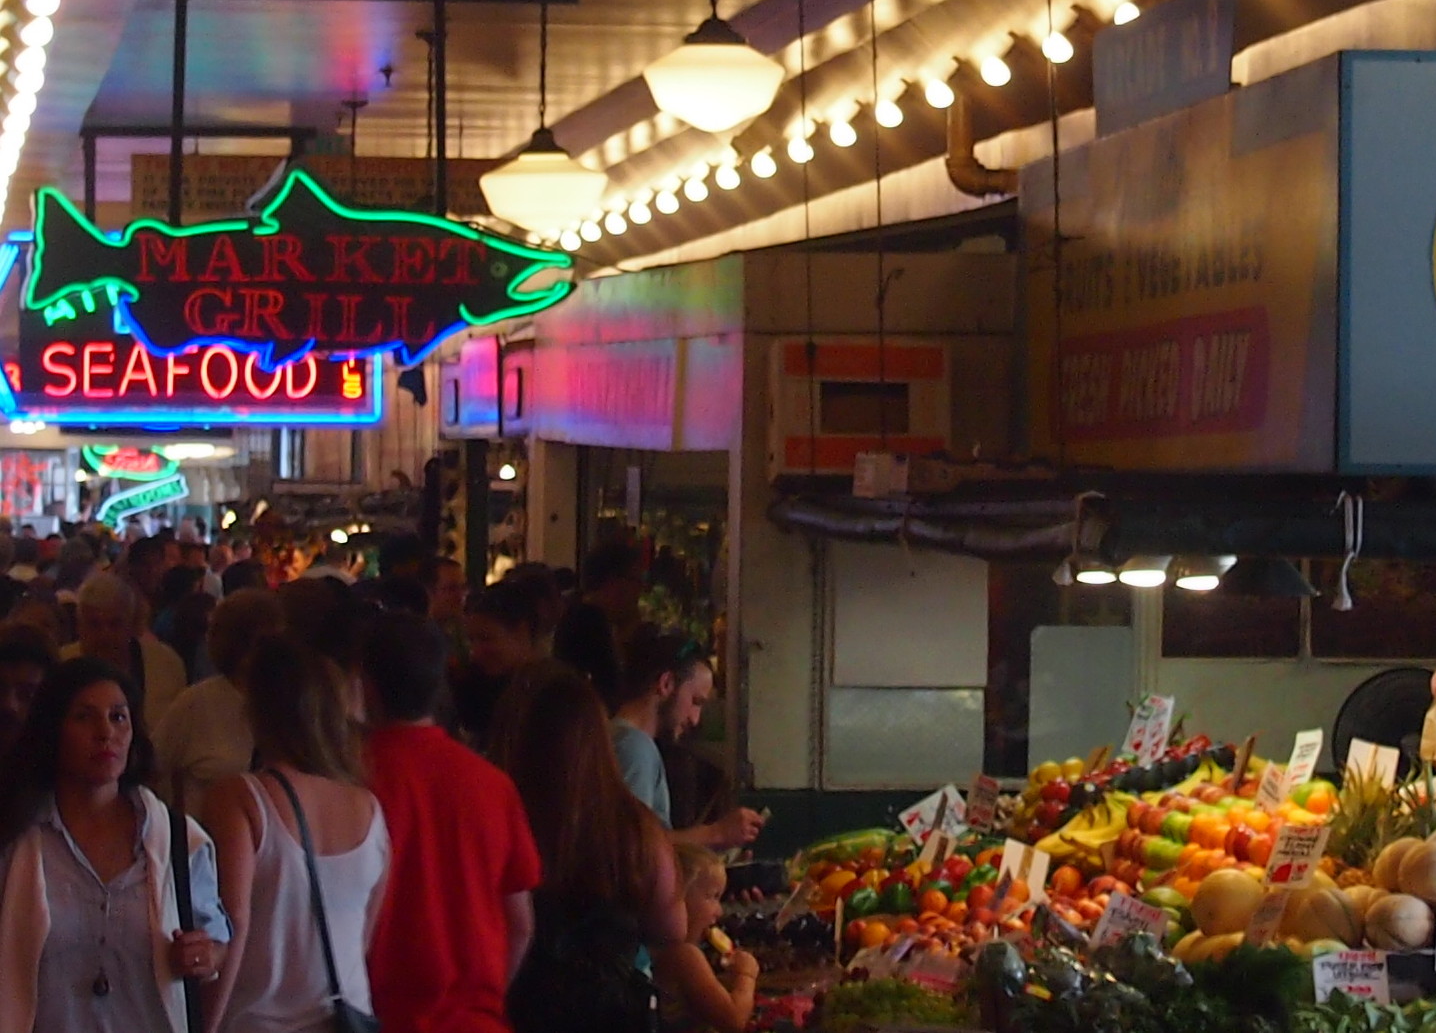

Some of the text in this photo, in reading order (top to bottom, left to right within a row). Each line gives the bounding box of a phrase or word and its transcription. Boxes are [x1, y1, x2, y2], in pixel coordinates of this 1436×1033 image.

[135, 232, 487, 285] MARKET
[183, 286, 436, 342] GRILL
[42, 341, 318, 400] SEAFOOD
